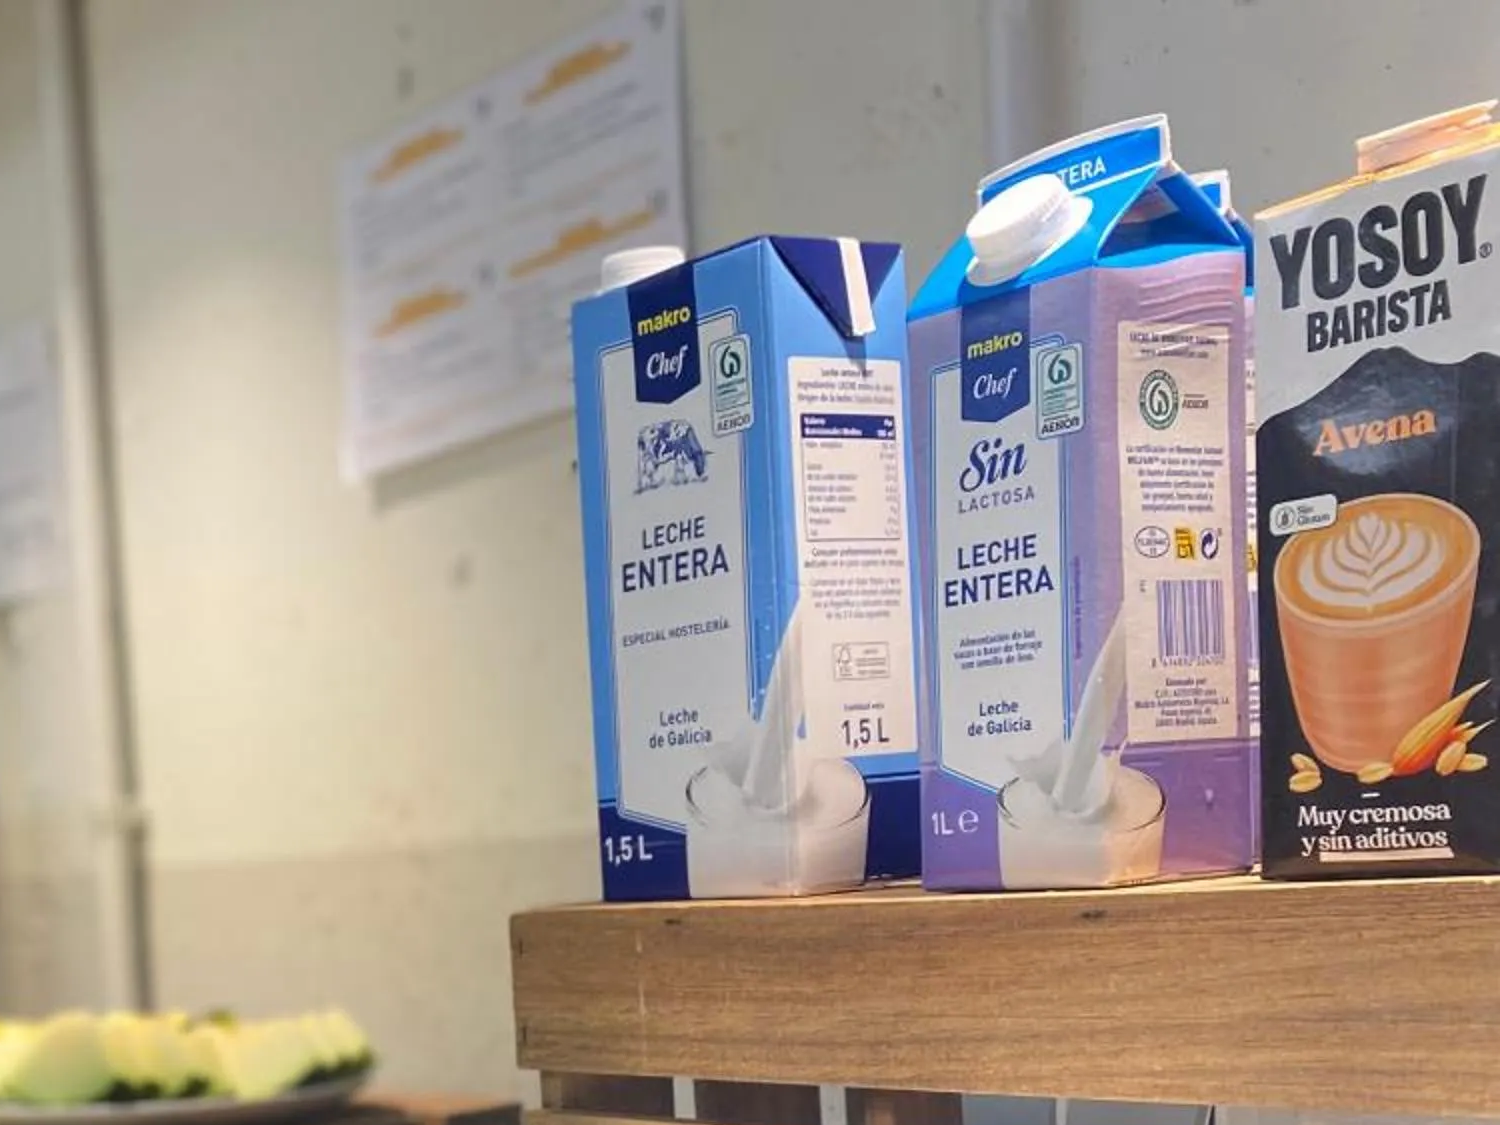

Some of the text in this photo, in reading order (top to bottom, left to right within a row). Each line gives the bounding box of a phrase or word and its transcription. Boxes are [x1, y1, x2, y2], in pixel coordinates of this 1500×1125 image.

[1056, 155, 1107, 187] TERA
[1269, 173, 1488, 310] YOSOY
[637, 305, 691, 336] makro
[1306, 279, 1452, 353] BARISTA
[967, 330, 1023, 360] makro
[646, 344, 689, 380] Chef
[972, 367, 1018, 400] Chef
[1312, 408, 1437, 457] Avena
[959, 438, 1028, 493] Sin
[957, 485, 1036, 515] LACTOSA
[642, 516, 706, 551] LECHE
[621, 543, 730, 593] ENTERA
[957, 534, 1037, 571] LECHE
[944, 564, 1055, 608] ENTERA
[622, 630, 667, 648] ESPECIAL
[659, 708, 699, 728] Leche
[979, 701, 1020, 718] Leche
[649, 726, 713, 749] de Galicia
[840, 716, 890, 750] 1,5 L
[967, 717, 1033, 738] de Galicia
[931, 812, 955, 836] 1L
[1297, 801, 1453, 831] Muy cremosa
[604, 835, 653, 865] 1,5 L
[1301, 826, 1449, 857] y sin aditivos
